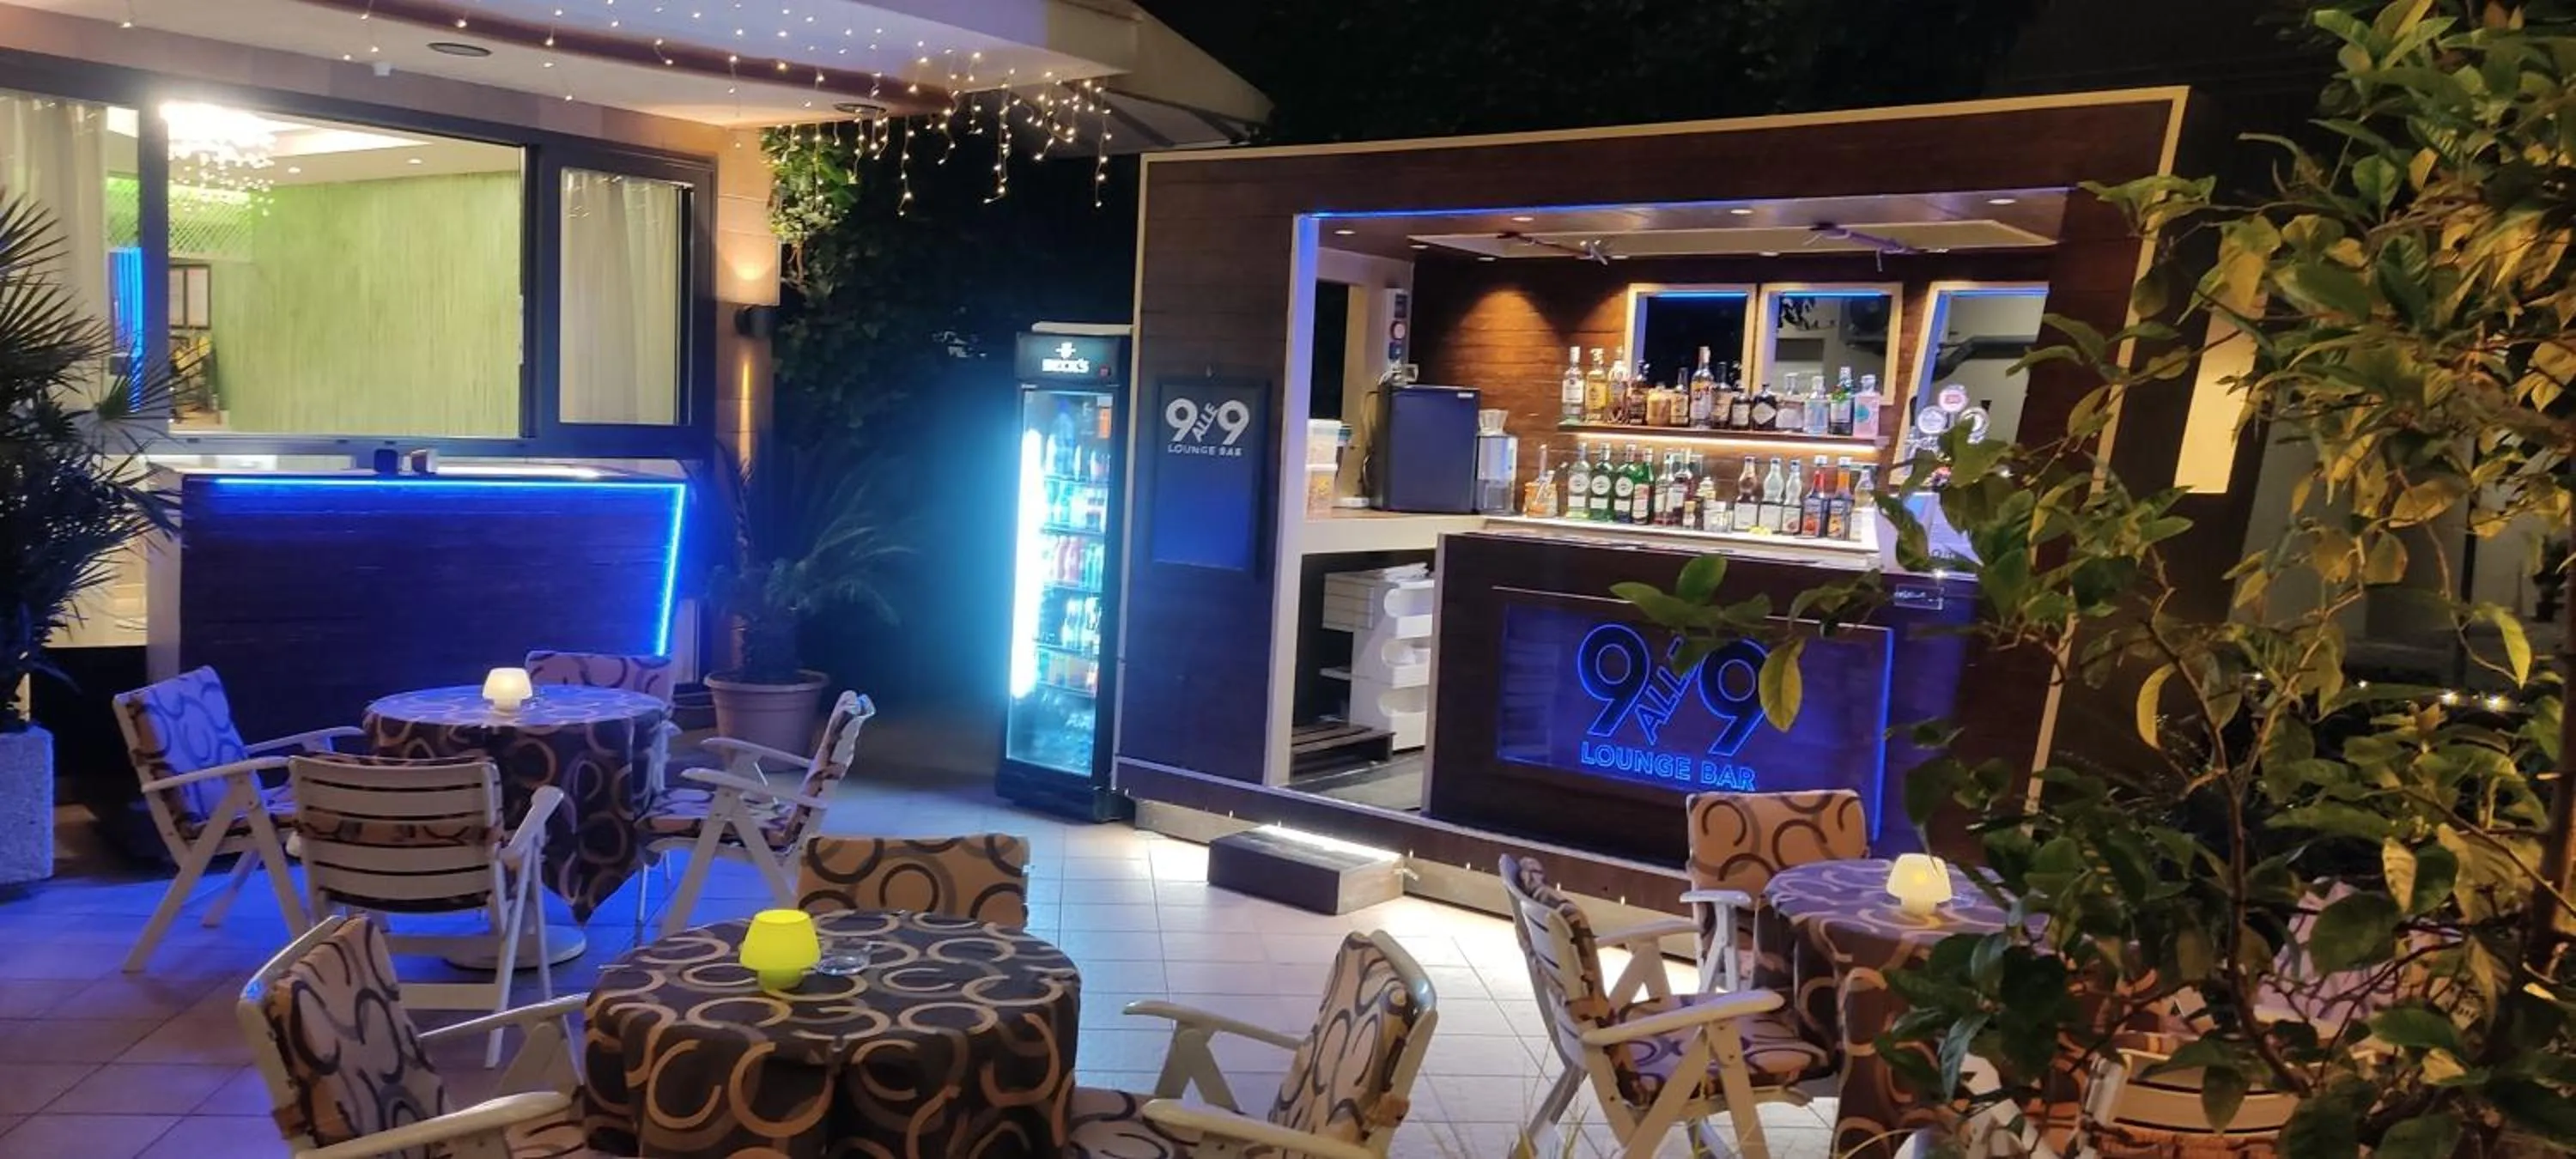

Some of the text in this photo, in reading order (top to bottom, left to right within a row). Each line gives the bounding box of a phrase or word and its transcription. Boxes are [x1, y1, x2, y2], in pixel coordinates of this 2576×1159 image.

[1166, 397, 1249, 445] 9 ALLE 9
[1168, 444, 1242, 456] LOUNGE BAR
[1577, 624, 1650, 737] 9
[1698, 638, 1769, 757] 9
[1580, 741, 1757, 792] LOUNGE BAR
